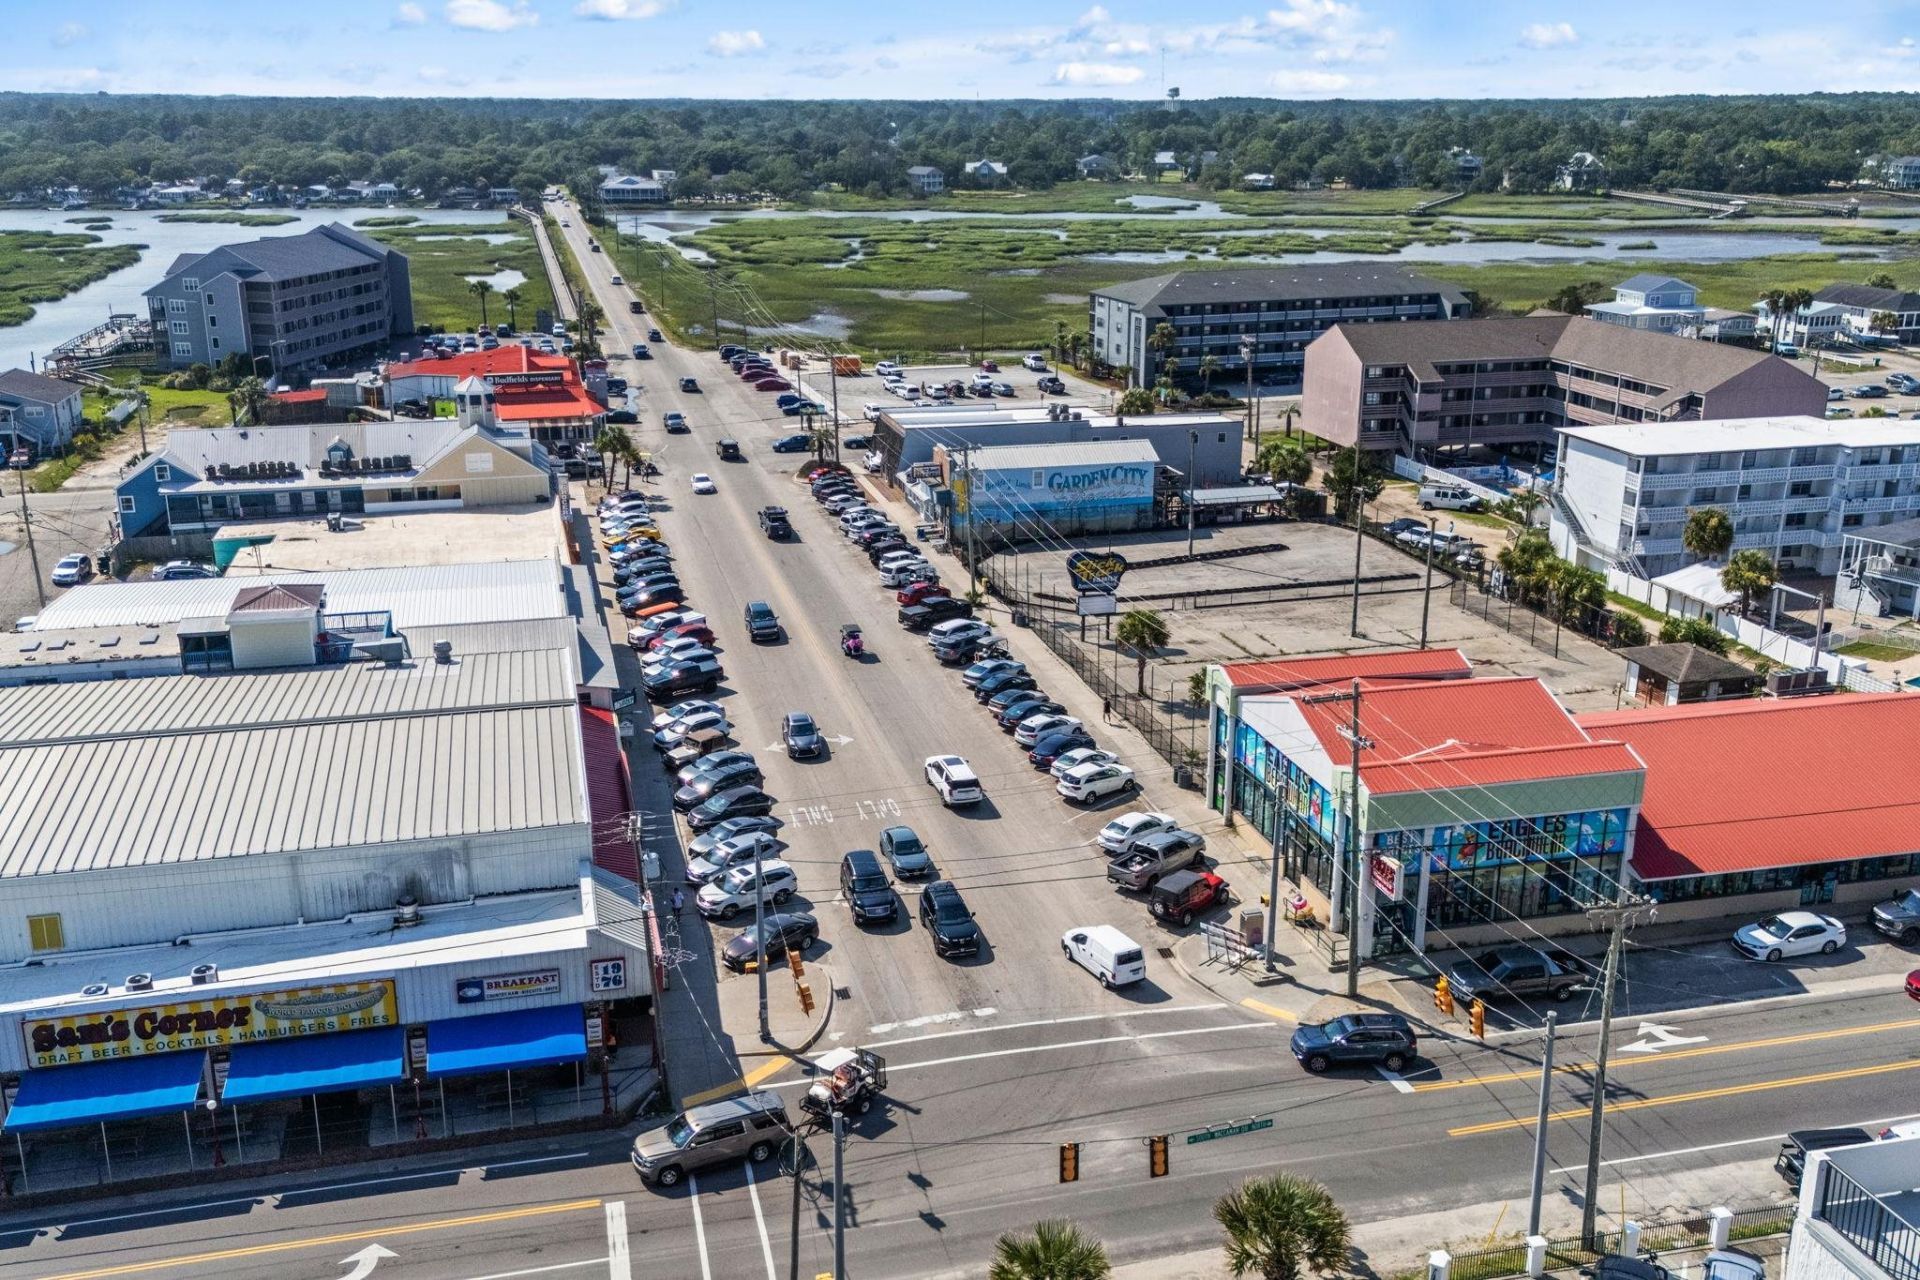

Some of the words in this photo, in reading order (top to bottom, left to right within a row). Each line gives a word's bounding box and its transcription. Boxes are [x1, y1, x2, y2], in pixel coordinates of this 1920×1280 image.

[1048, 468, 1111, 494] GARDEN
[1111, 466, 1149, 486] CITY
[789, 805, 834, 828] ONLY
[856, 798, 902, 821] ONLY
[1488, 815, 1567, 839] EAGLES
[1486, 834, 1567, 860] BEACHWEAR
[602, 962, 622, 976] 19
[486, 974, 557, 989] BREAKFAST
[601, 975, 623, 988] 76
[31, 1015, 131, 1053] Sam's
[134, 1006, 251, 1040] Corner
[38, 1051, 84, 1065] DRAFT
[92, 1046, 131, 1059] BEER
[145, 1034, 223, 1051] COCKTAILS
[239, 1020, 336, 1041] HAMBURGERS
[351, 1014, 390, 1027] FRIES
